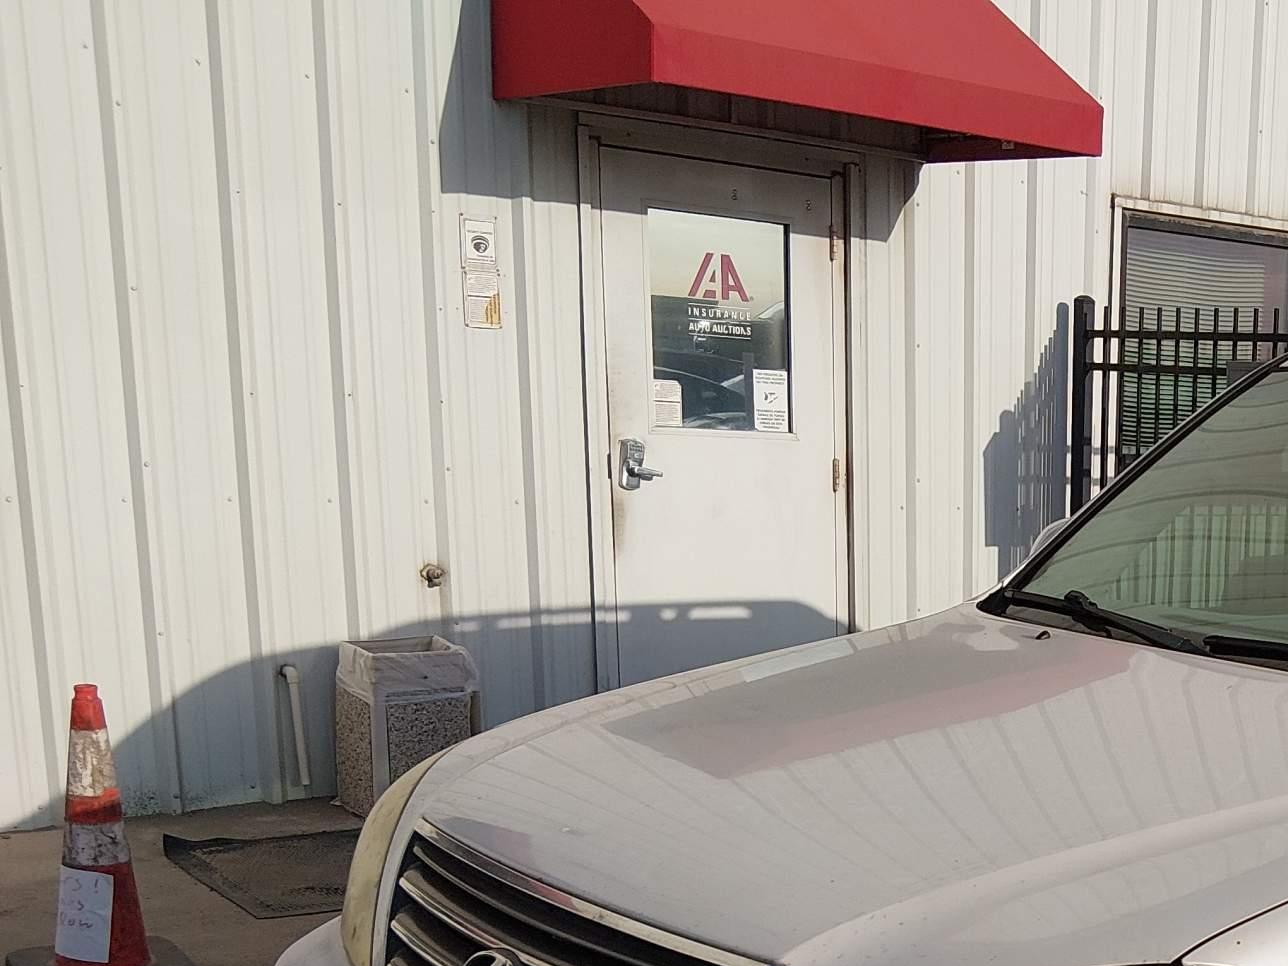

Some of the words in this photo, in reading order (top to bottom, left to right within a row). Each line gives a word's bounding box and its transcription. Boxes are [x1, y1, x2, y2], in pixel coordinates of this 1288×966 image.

[688, 307, 751, 321] INSURANCE
[688, 321, 710, 334] AUTO
[712, 323, 752, 336] AUCTIONS
